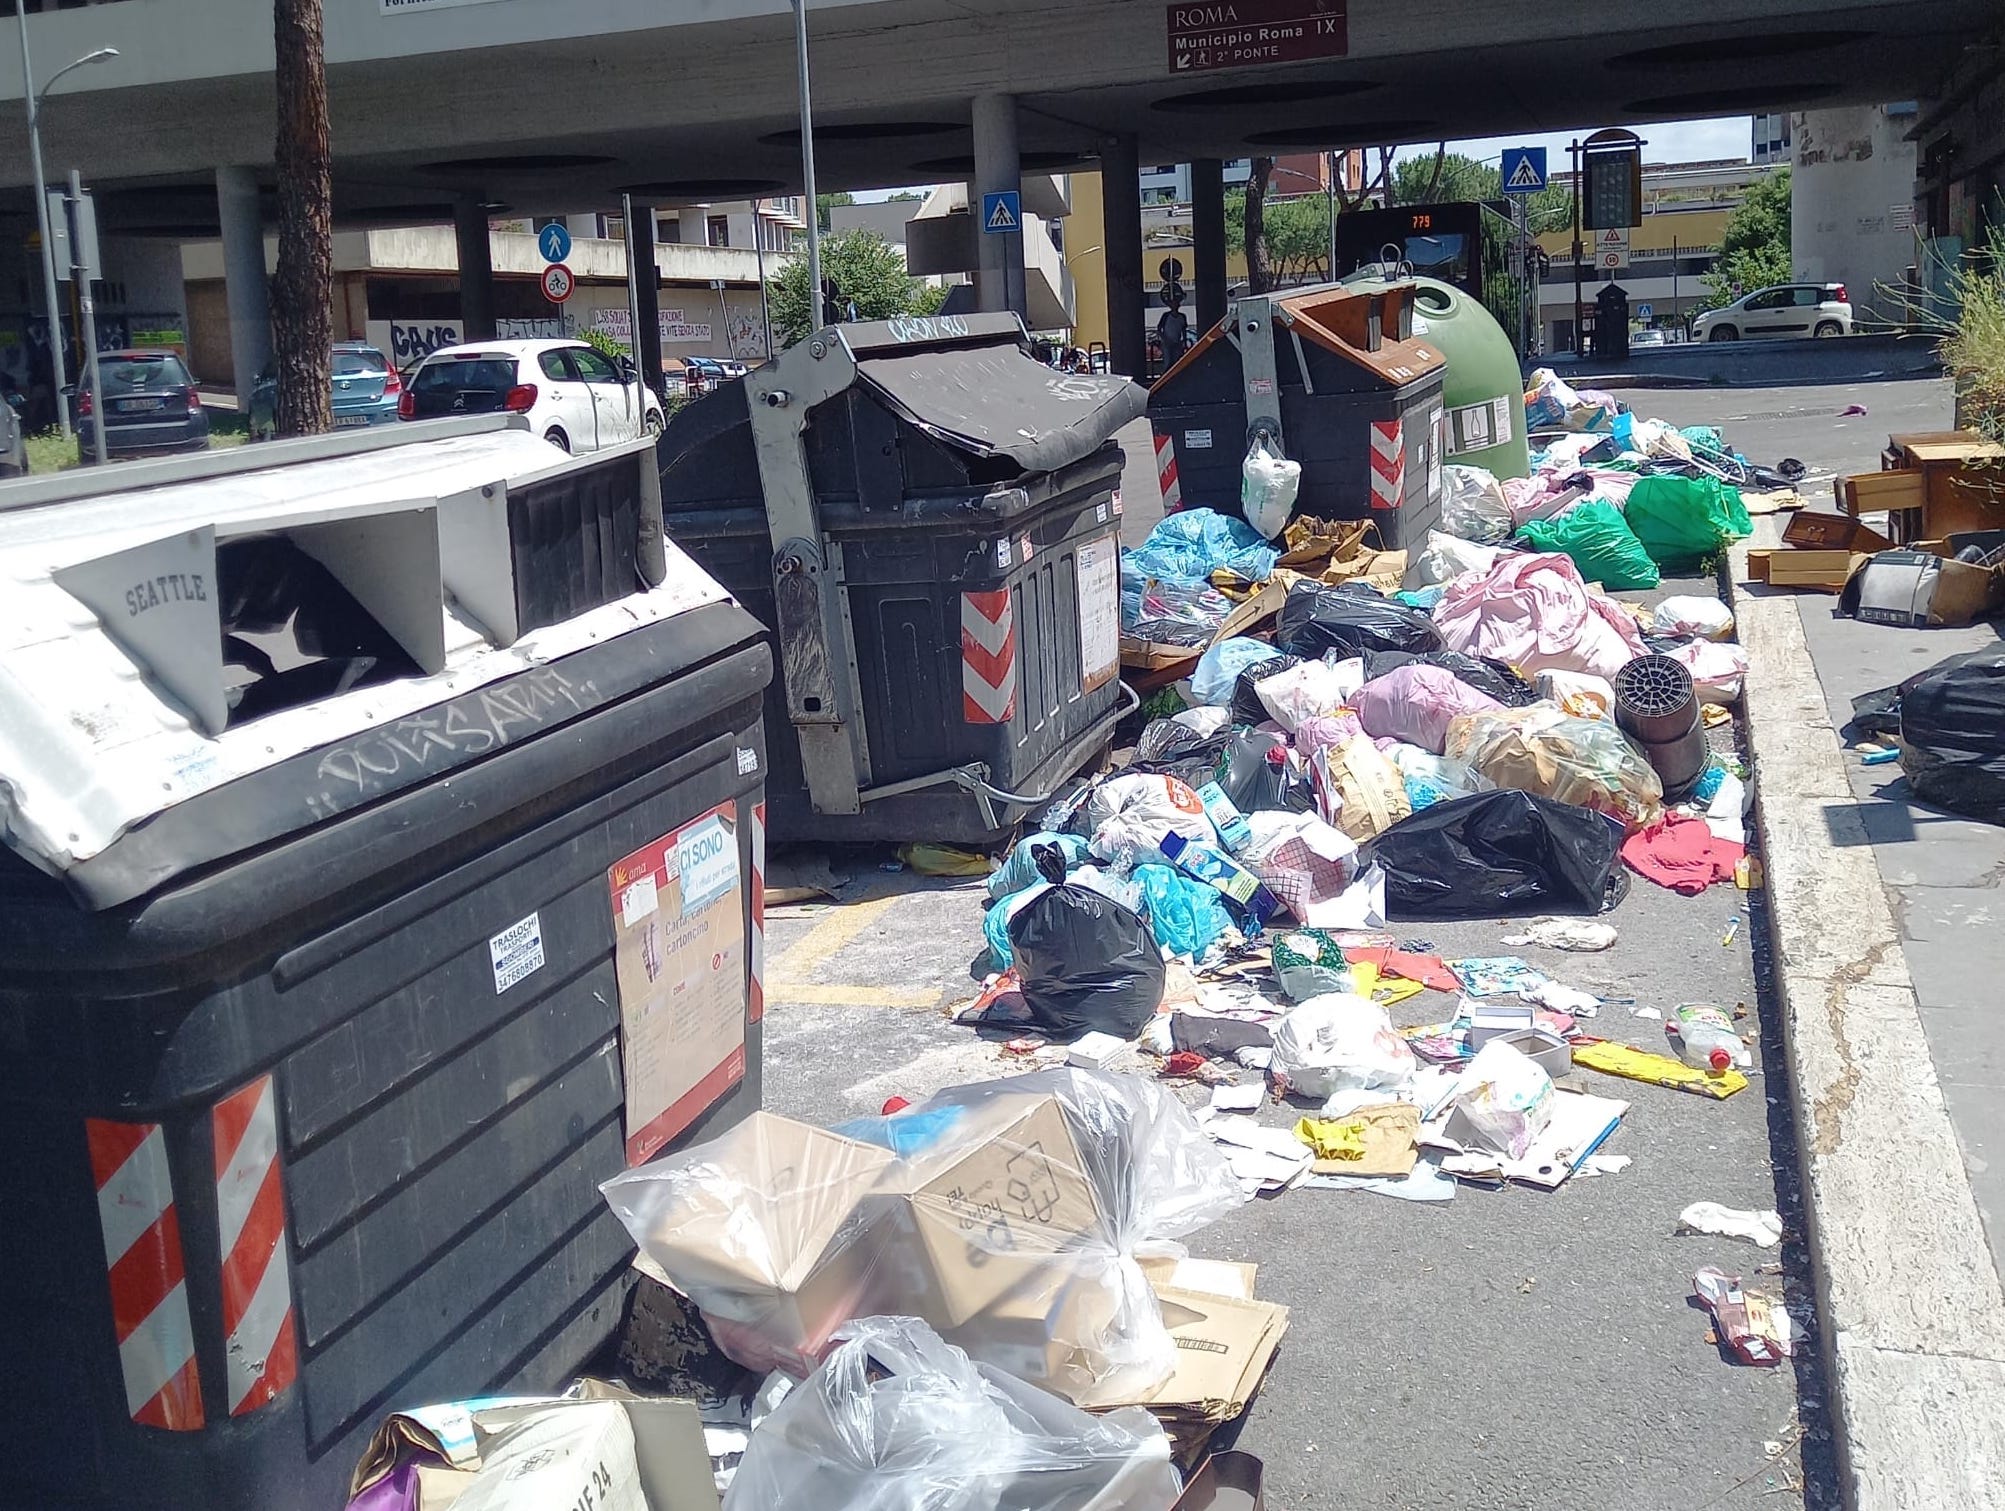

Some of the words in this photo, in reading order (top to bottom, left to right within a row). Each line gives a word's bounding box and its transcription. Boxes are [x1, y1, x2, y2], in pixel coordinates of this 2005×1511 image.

[1176, 5, 1238, 27] ROMA
[1175, 32, 1252, 50] Municipio
[1259, 26, 1304, 41] Roma
[1317, 19, 1336, 34] IX
[1234, 46, 1279, 60] PONTE
[1413, 216, 1430, 229] 779
[678, 325, 695, 336] SENZA
[695, 324, 710, 336] STATO
[125, 574, 207, 617] SEATTLE
[680, 848, 692, 871] CI
[692, 830, 723, 867] SONO
[628, 863, 647, 880] ama
[492, 916, 537, 951] TRASLOCHI
[500, 930, 533, 954] TRASPORTI
[665, 920, 709, 956] cartoncino
[592, 1460, 611, 1501] 24
